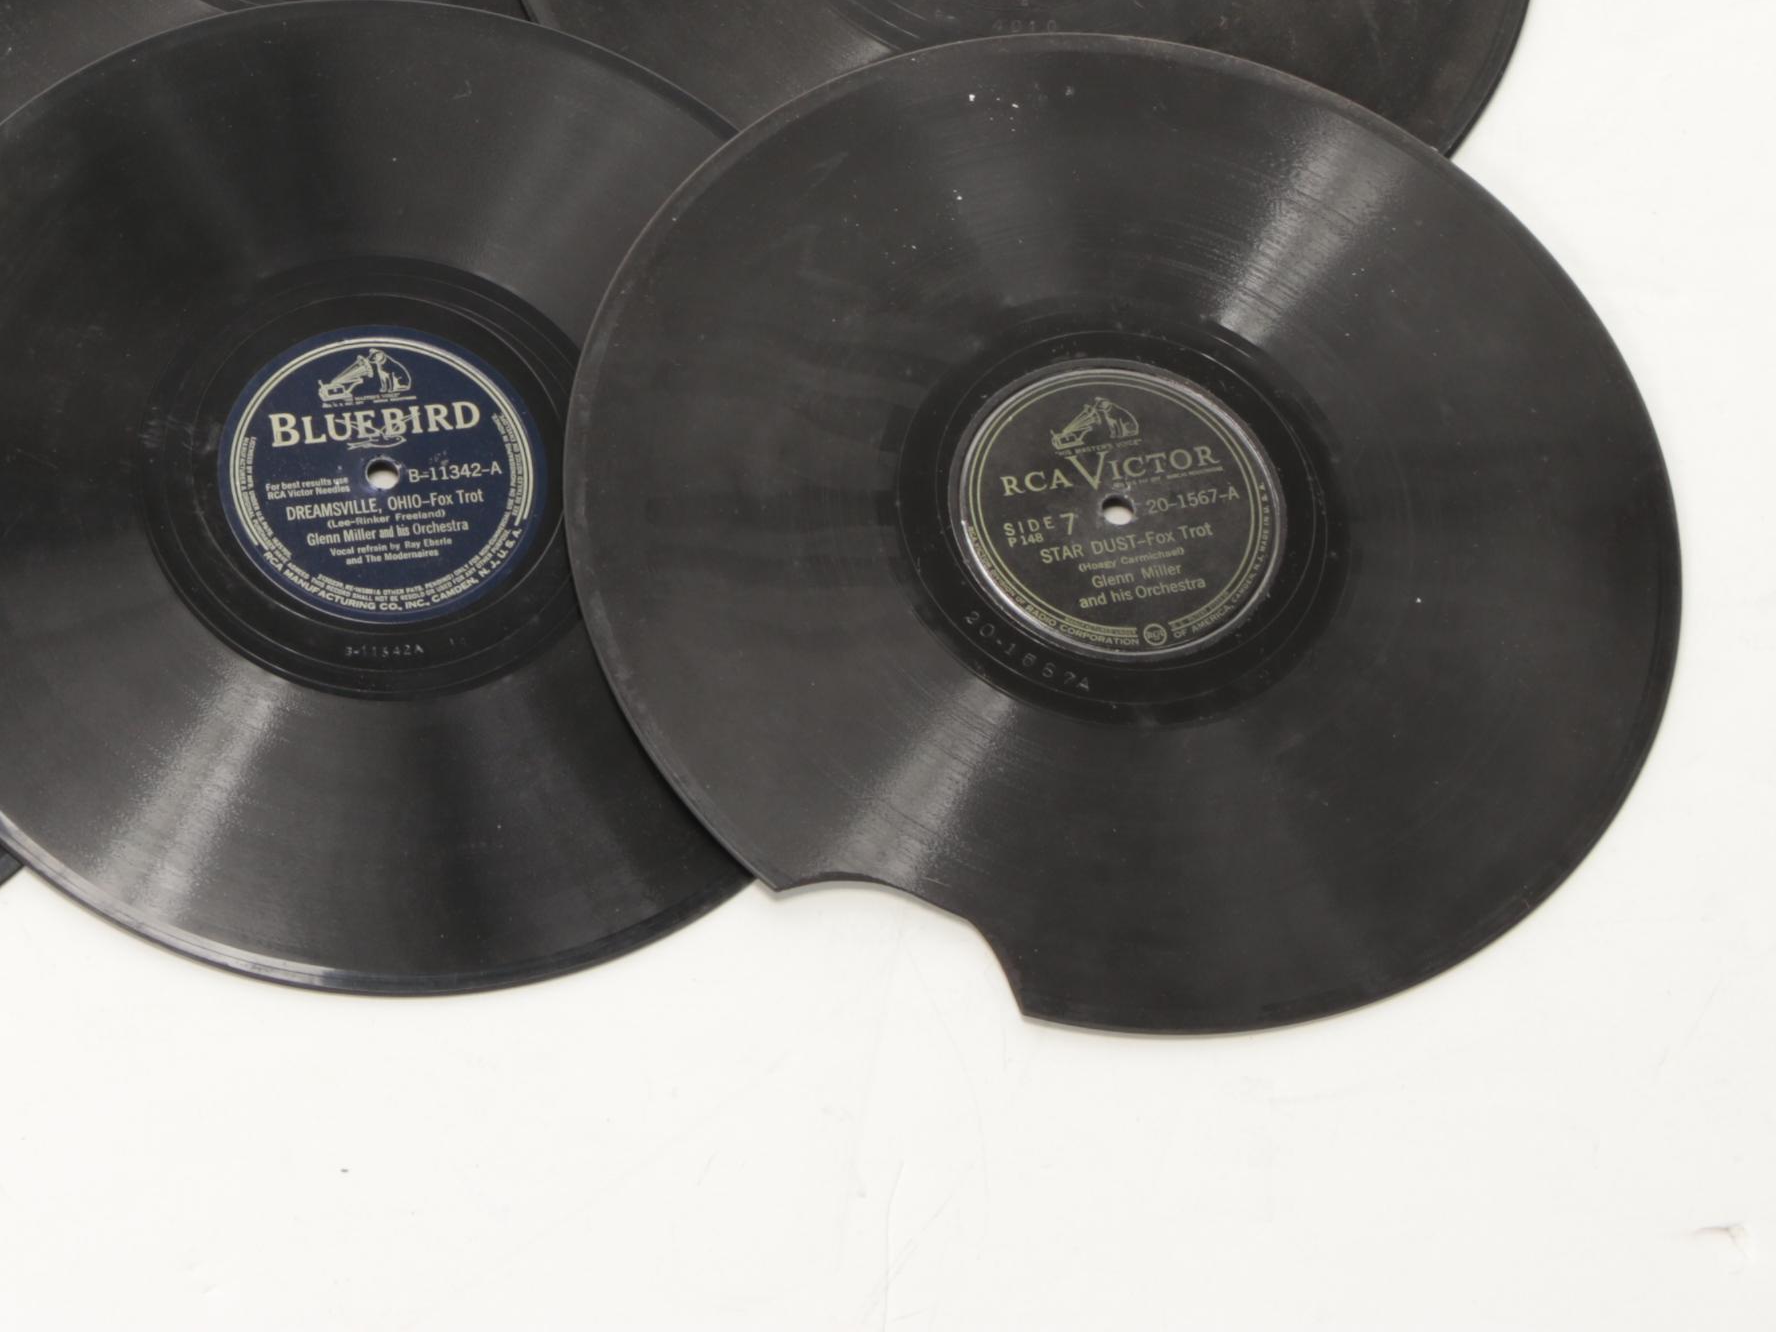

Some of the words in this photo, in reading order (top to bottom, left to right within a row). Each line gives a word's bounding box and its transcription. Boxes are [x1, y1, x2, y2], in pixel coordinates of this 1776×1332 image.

[268, 401, 481, 448] BLUEBIRD
[1000, 470, 1073, 496] RCA
[1064, 445, 1220, 490] VICTOR
[287, 498, 382, 521] DREAMSVILLE,
[456, 489, 484, 504] Trot
[1147, 486, 1239, 514] 20-1567-A
[307, 531, 340, 546] Glenn
[343, 527, 376, 542] Miller
[380, 527, 394, 538] and
[397, 525, 410, 537] his
[413, 521, 469, 535] Orchestra
[1004, 516, 1055, 537] SIDE
[1060, 513, 1077, 535] 7
[1040, 544, 1083, 564] STAR
[1178, 522, 1213, 539] Trot
[263, 551, 282, 570] RCA
[284, 570, 375, 611] MANUFACTURING
[1092, 571, 1134, 588] Glenn
[1141, 564, 1181, 581] Miller
[1079, 595, 1107, 609] and
[1111, 590, 1133, 603] his
[1135, 577, 1206, 599] Orchestra
